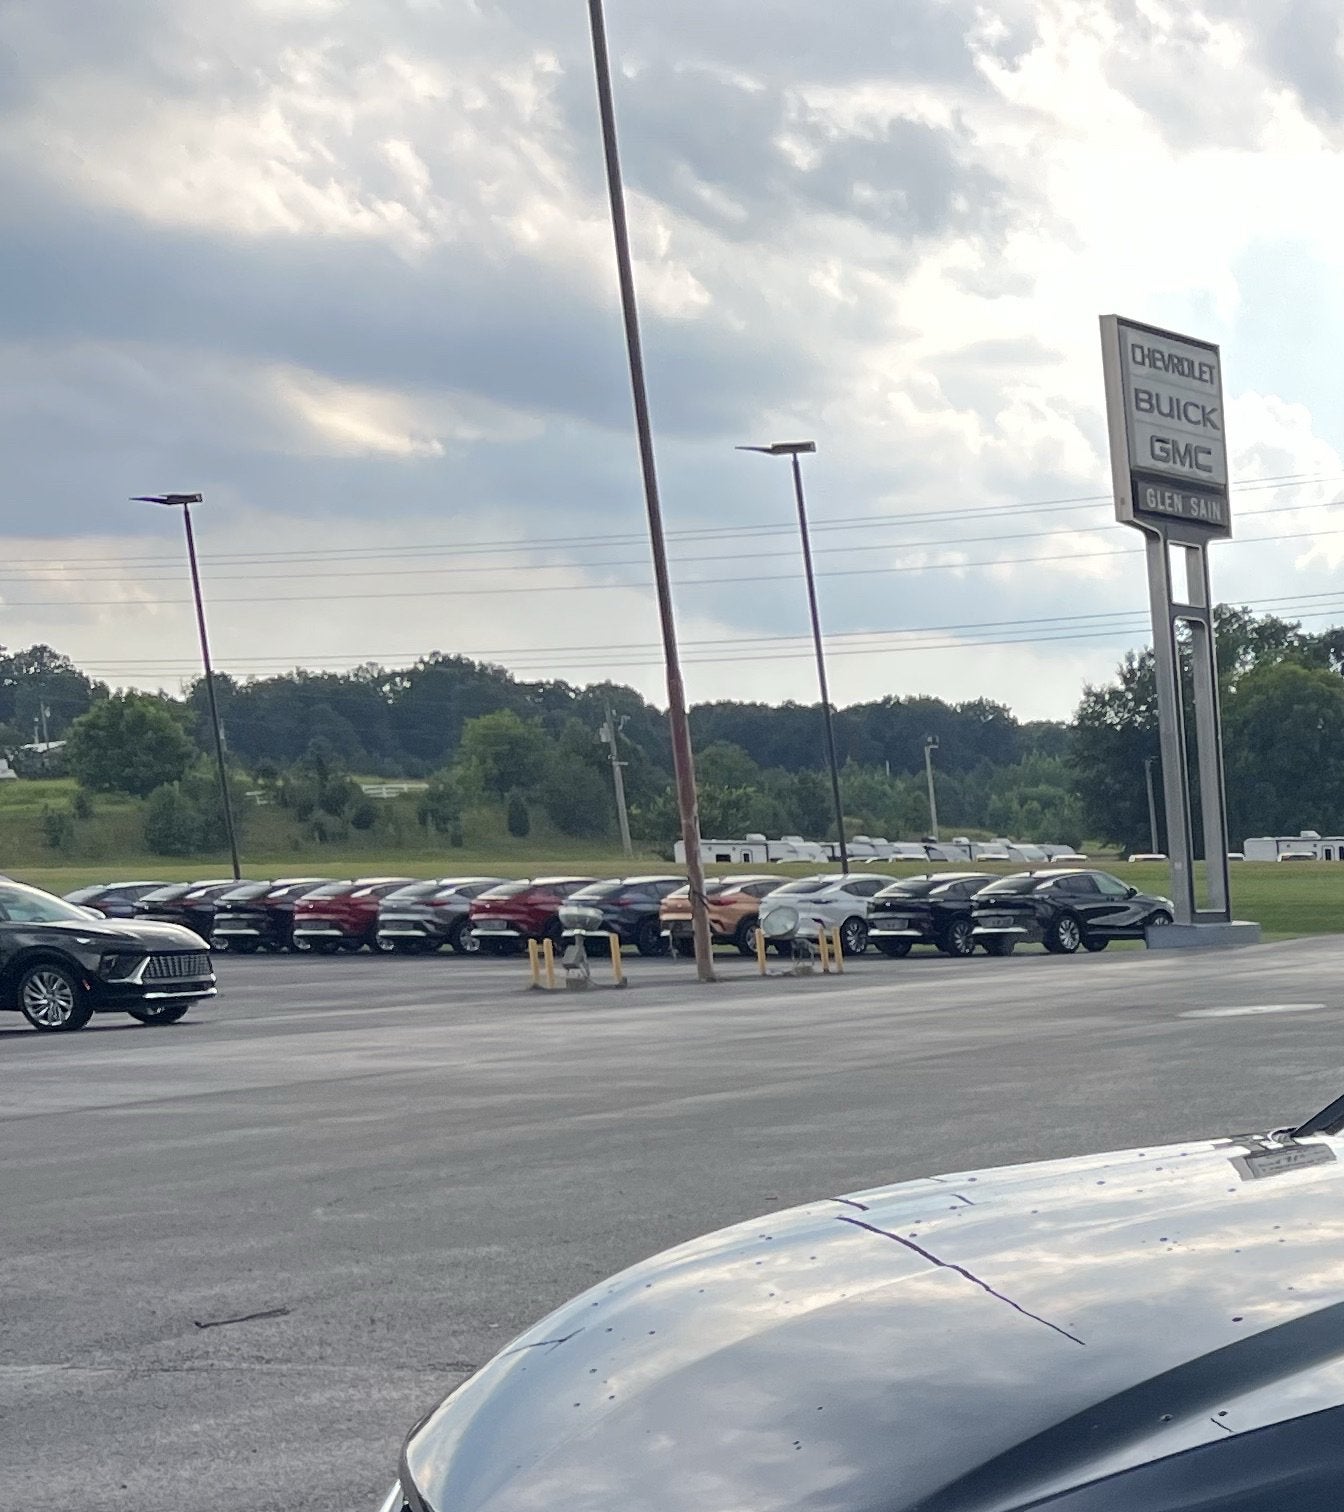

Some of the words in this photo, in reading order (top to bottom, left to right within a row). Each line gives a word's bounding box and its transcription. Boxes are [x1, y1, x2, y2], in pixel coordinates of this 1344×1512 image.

[1131, 343, 1215, 385] CHEVROLET
[1134, 388, 1220, 431] BUICK
[1150, 434, 1213, 474] GMC
[1146, 487, 1183, 512] GLEN
[1190, 498, 1221, 521] SAIN
